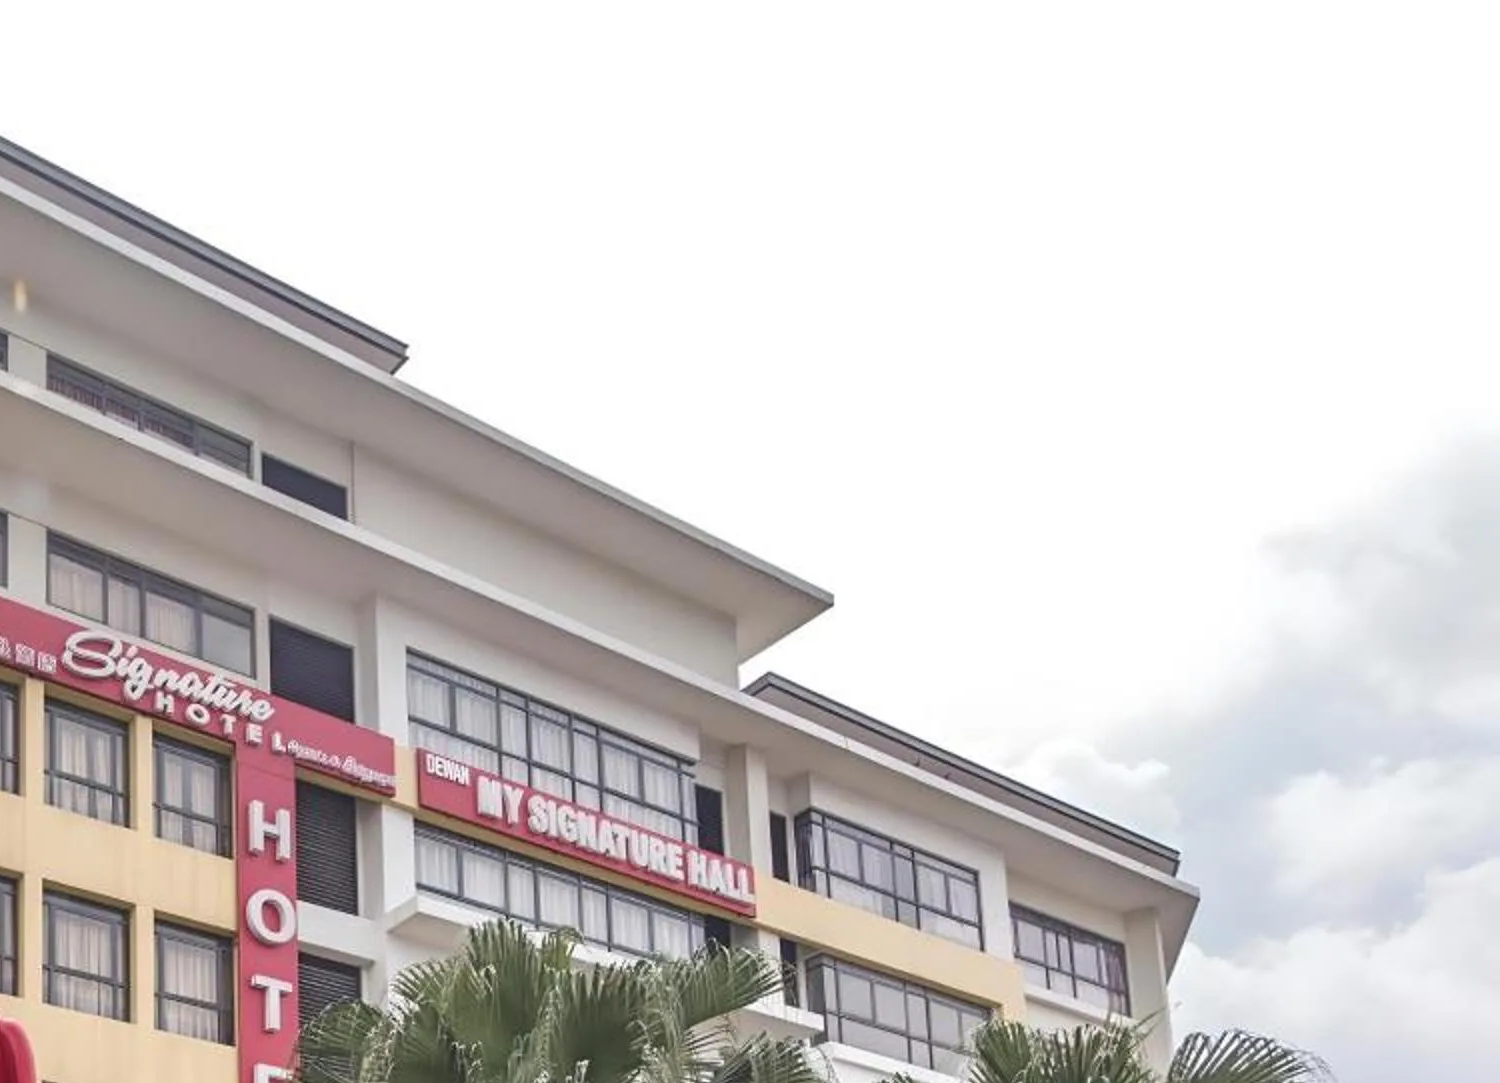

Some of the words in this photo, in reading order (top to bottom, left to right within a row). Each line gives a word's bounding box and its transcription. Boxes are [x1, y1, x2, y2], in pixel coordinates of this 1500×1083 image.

[61, 629, 275, 722] Signature
[155, 690, 287, 754] HOTEL
[425, 753, 470, 787] DEWAN
[477, 775, 525, 827] MY
[526, 794, 684, 881] SIGNATURE
[687, 849, 755, 905] HALL
